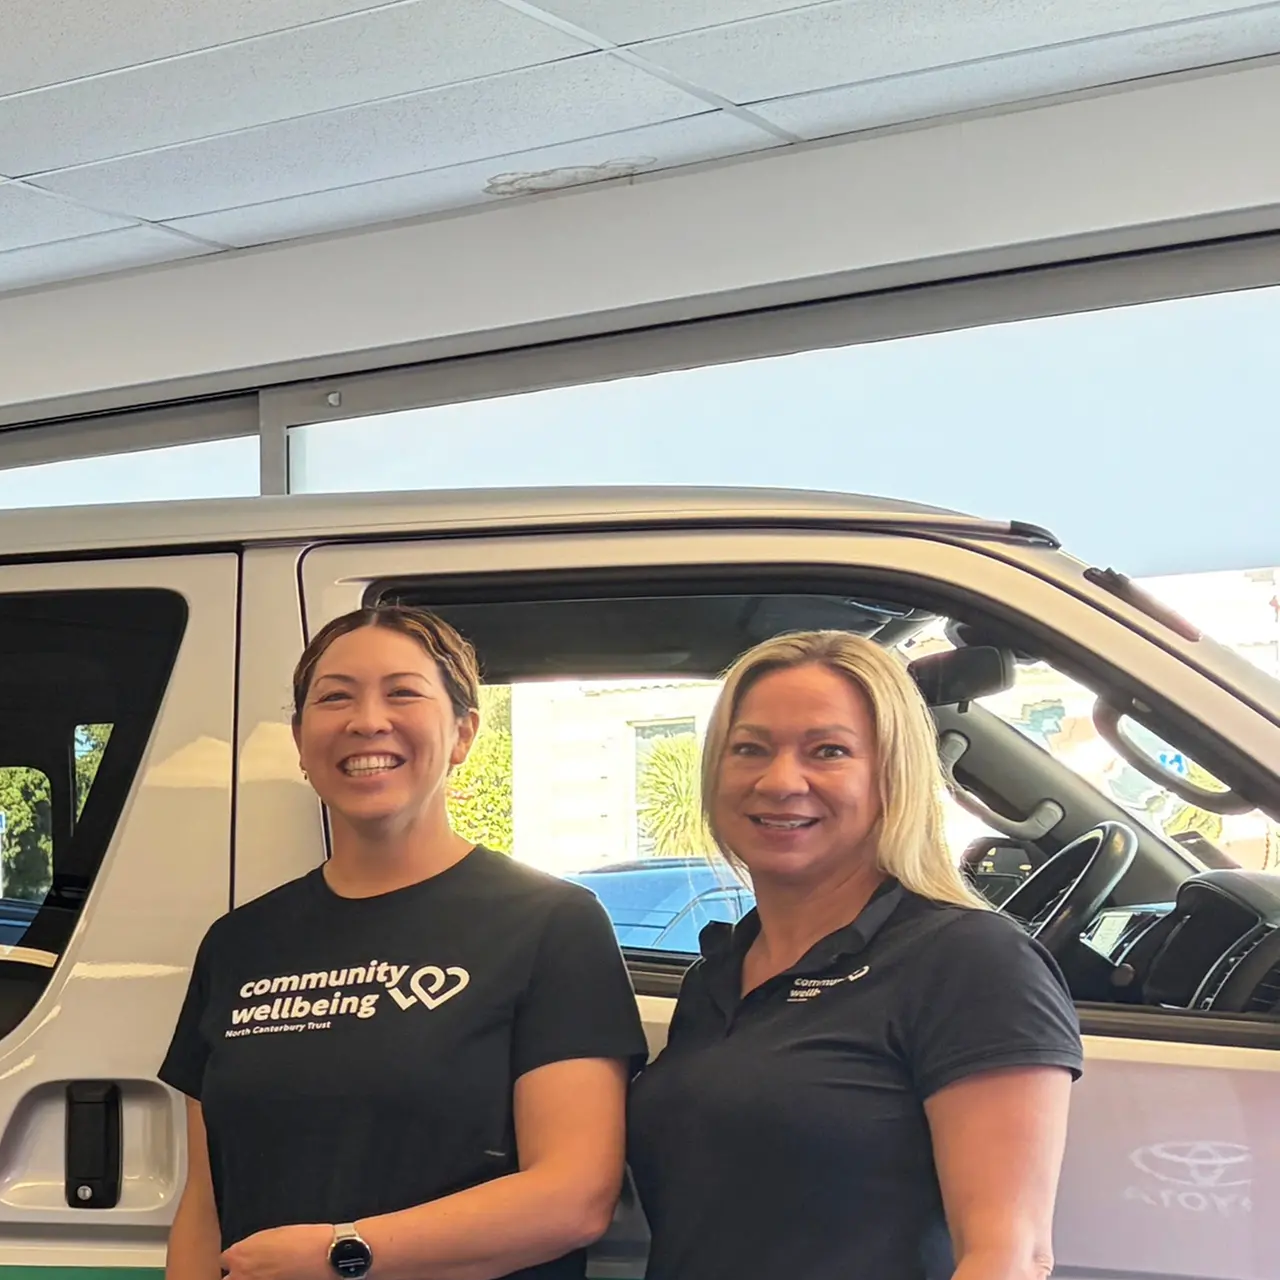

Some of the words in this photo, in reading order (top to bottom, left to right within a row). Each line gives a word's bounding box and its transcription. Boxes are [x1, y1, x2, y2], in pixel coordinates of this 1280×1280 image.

[239, 960, 410, 998] community
[231, 992, 380, 1025] wellbeing
[225, 1028, 251, 1038] North
[252, 1022, 305, 1035] Canterbury
[308, 1021, 332, 1030] Trust
